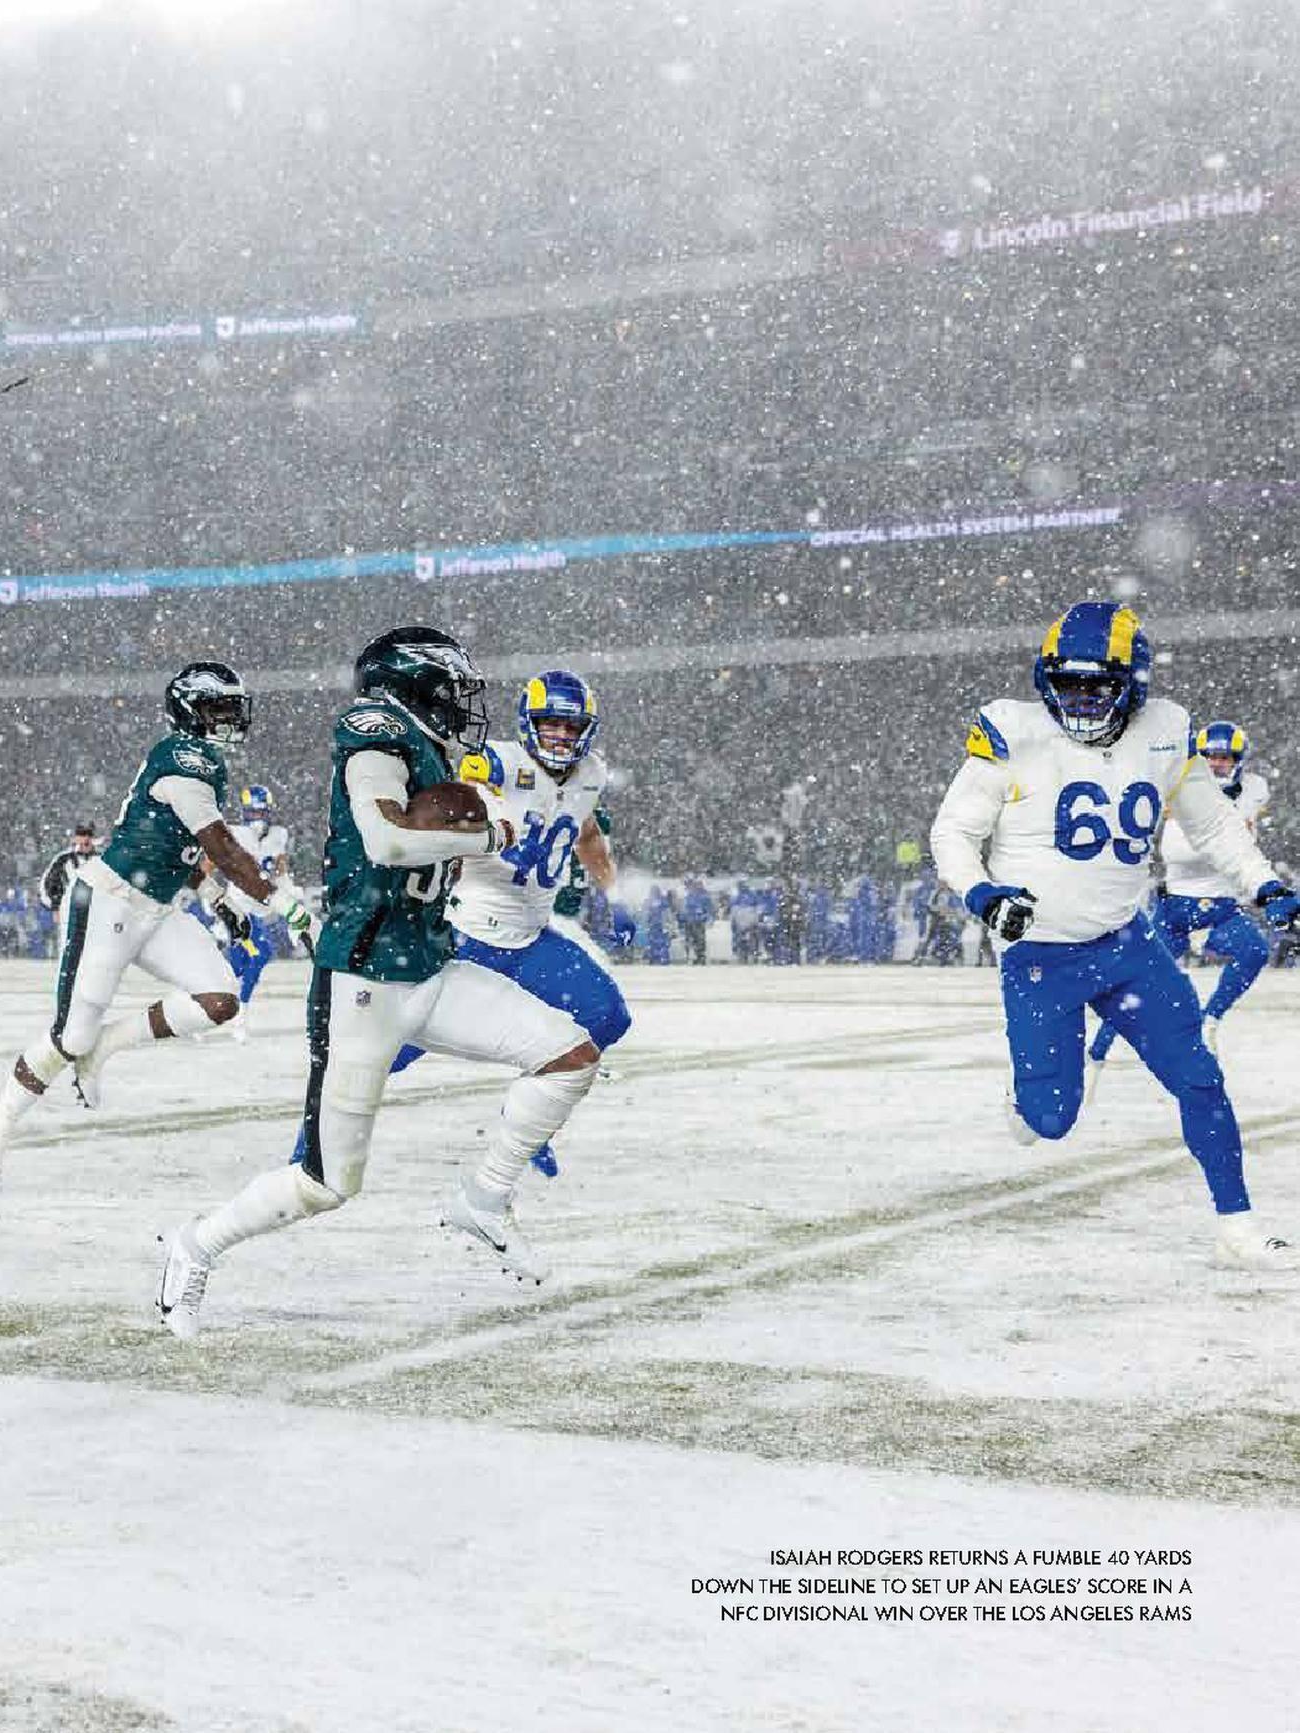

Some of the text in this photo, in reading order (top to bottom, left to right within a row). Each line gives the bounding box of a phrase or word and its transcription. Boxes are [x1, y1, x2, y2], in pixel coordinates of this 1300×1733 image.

[972, 187, 1262, 250] Lincoln Financial Field
[891, 520, 958, 543] HEALTH
[500, 810, 579, 890] 40
[1055, 780, 1162, 864] 69
